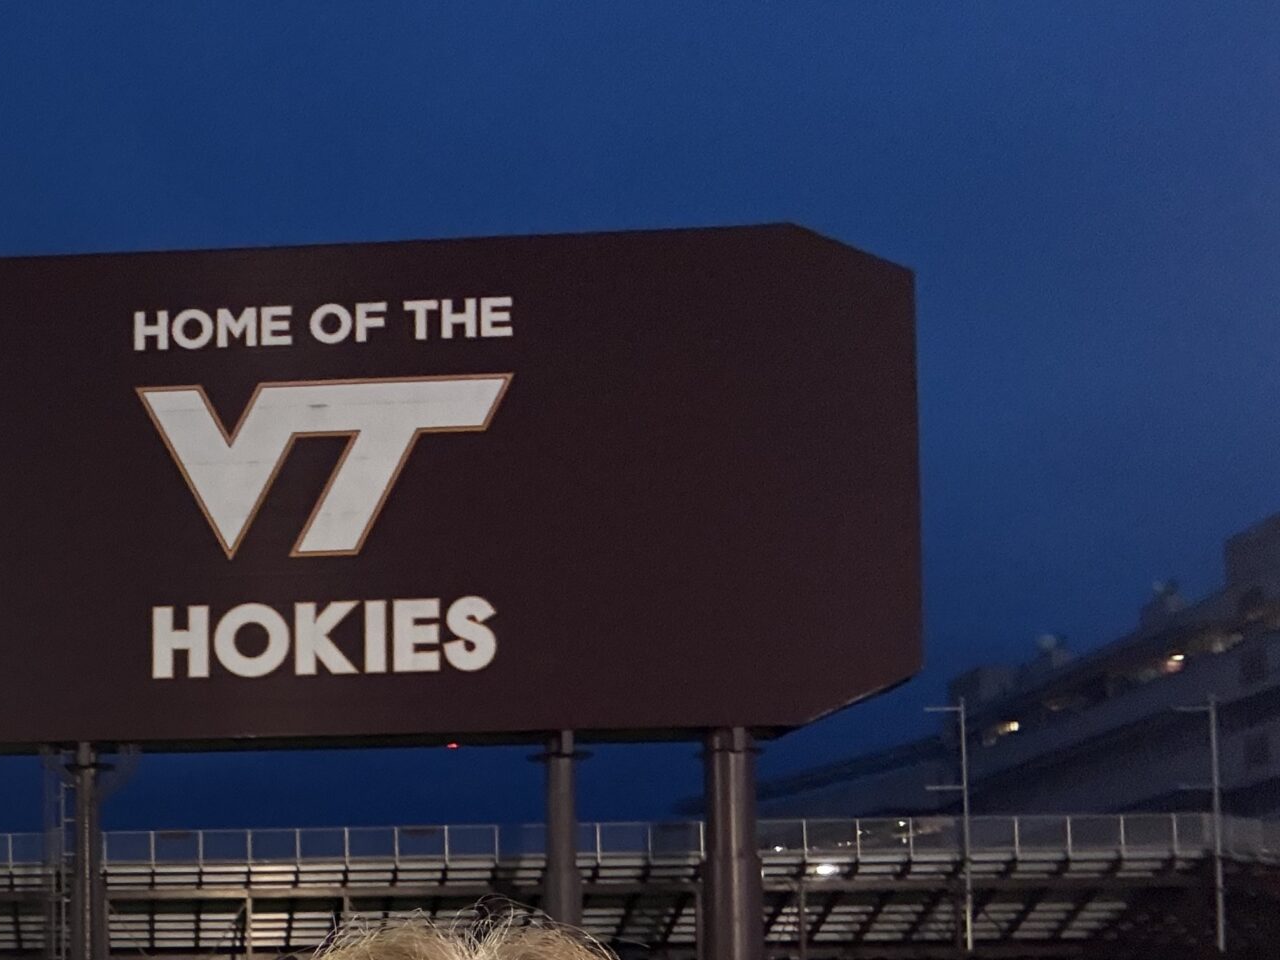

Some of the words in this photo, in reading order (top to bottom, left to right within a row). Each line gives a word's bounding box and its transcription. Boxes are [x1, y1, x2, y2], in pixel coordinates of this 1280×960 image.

[134, 306, 293, 351] HOME
[309, 302, 388, 344] OF
[403, 296, 514, 340] THE
[136, 373, 514, 560] VT
[152, 596, 497, 679] HOKIES
